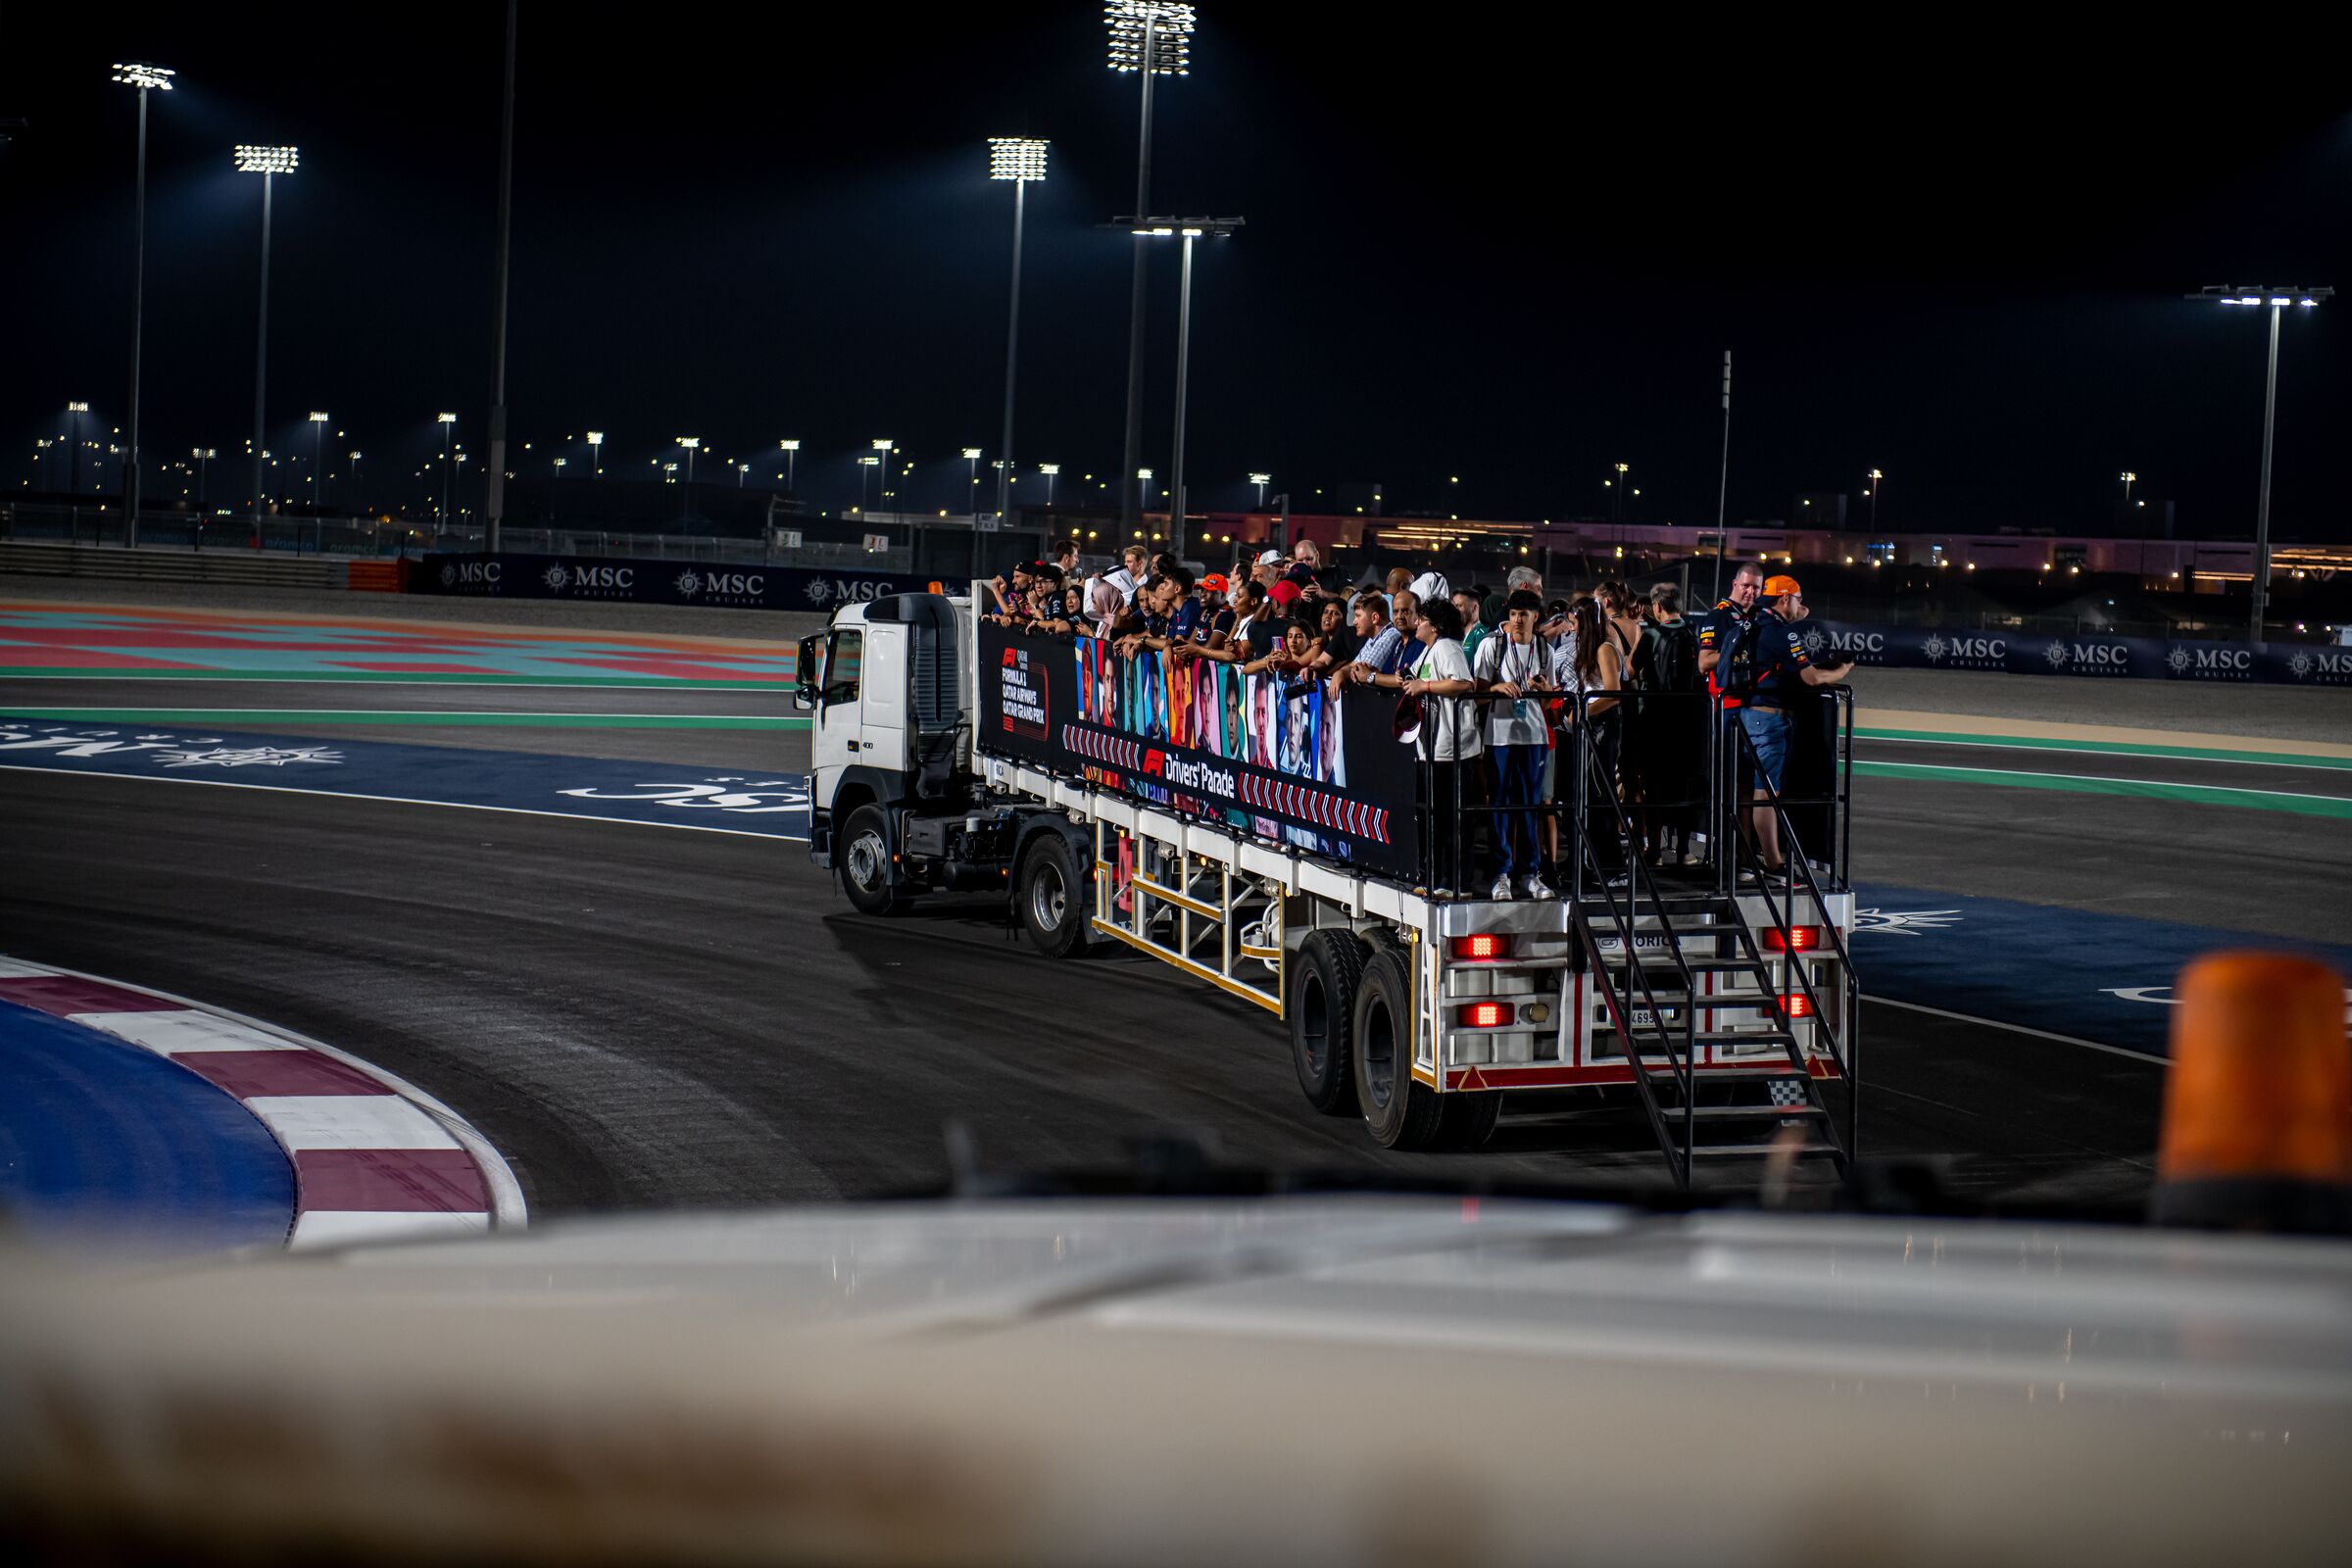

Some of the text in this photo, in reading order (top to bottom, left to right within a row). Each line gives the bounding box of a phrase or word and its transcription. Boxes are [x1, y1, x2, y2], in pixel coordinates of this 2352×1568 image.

[460, 562, 501, 583] MSC
[574, 565, 634, 588] MSC
[705, 571, 764, 595] MSC
[835, 579, 894, 601] MSC
[1829, 631, 1884, 653] MSC
[1951, 637, 2006, 659] MSC
[1950, 659, 2005, 667] CRUISES
[2073, 644, 2128, 664] MSC
[2195, 649, 2250, 669] MSC
[2072, 665, 2127, 674] CRUISES
[2195, 670, 2250, 679] CRUISES
[1018, 704, 1033, 721] GRAND
[1033, 709, 1045, 724] PRIX
[1165, 753, 1200, 788] Drivers'
[1201, 761, 1235, 799] Parade
